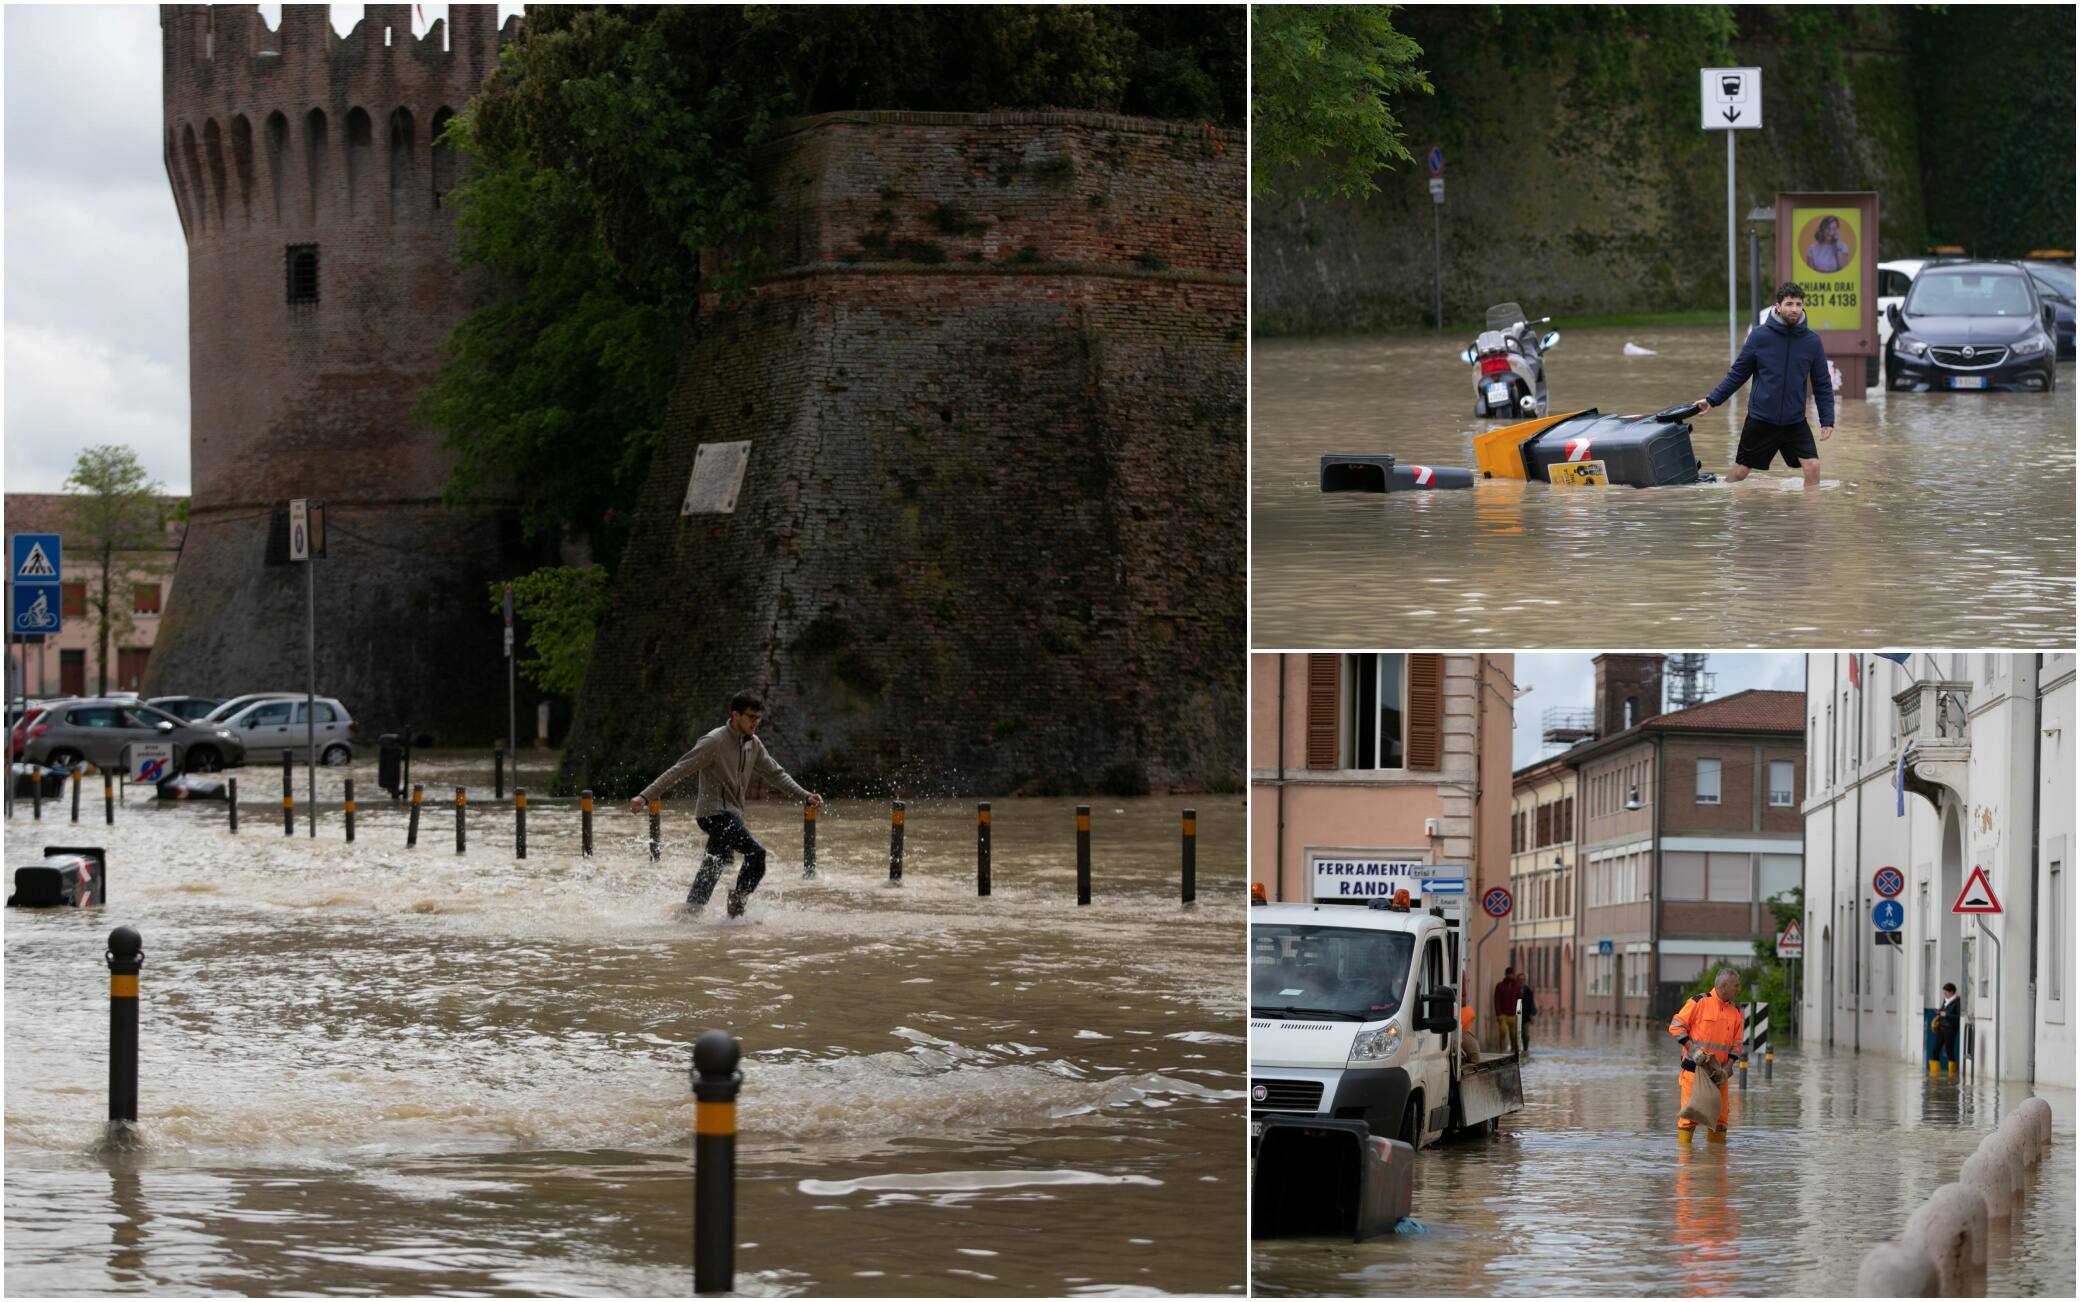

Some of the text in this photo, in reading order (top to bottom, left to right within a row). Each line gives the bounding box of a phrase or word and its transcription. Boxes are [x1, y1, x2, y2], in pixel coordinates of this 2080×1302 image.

[1799, 281, 1832, 292] CHIAMA
[1829, 294, 1857, 307] 4138
[1340, 881, 1395, 895] RANDI
